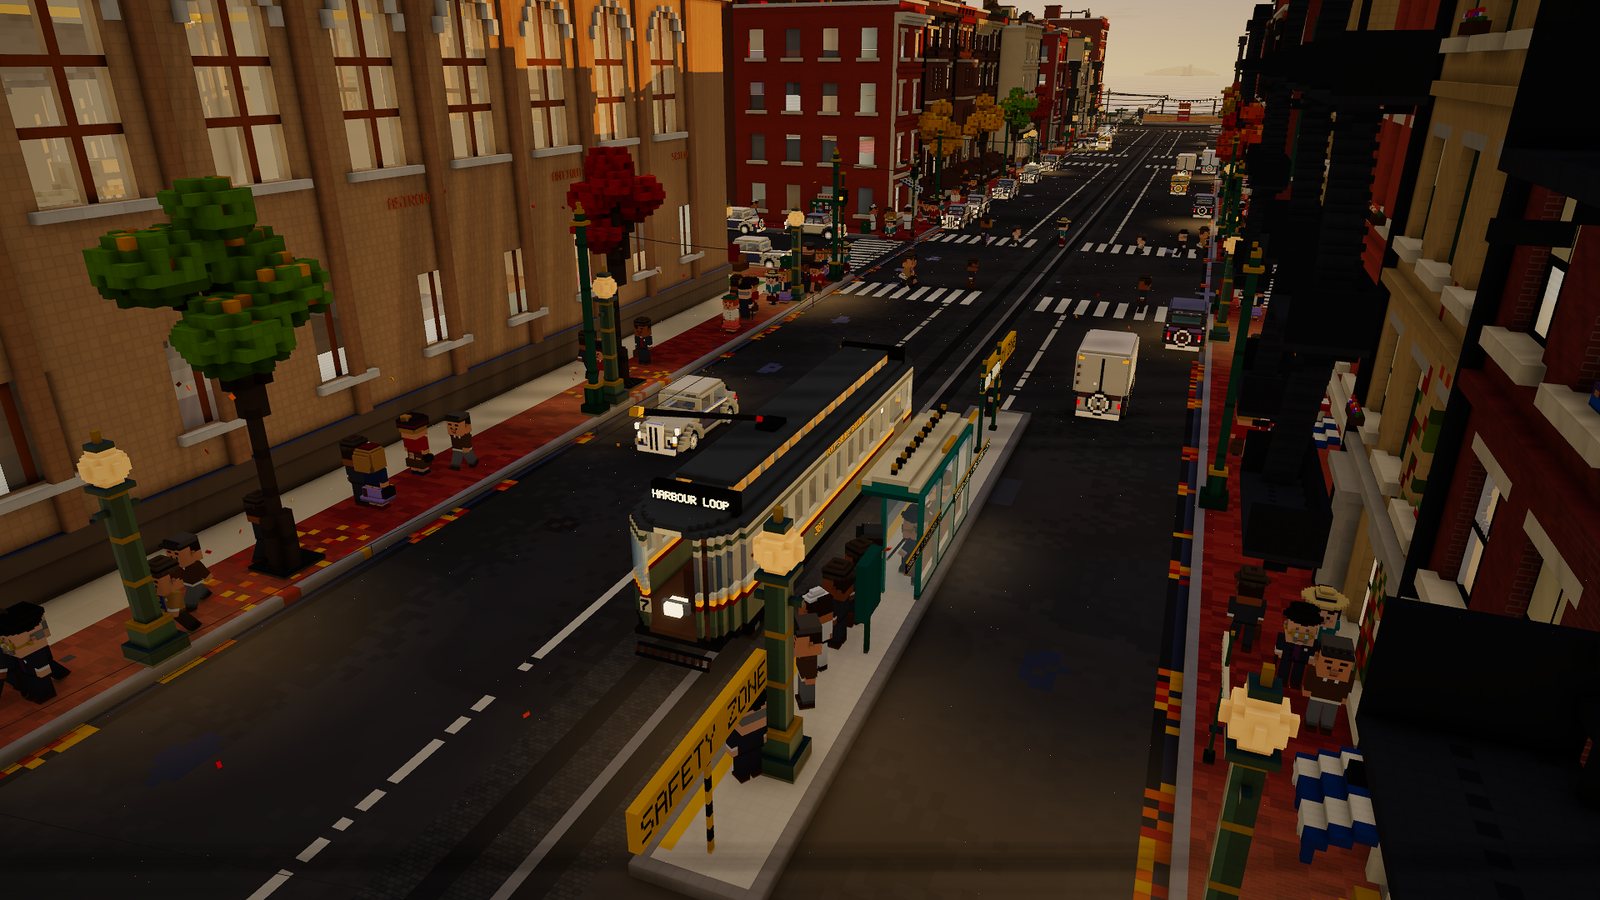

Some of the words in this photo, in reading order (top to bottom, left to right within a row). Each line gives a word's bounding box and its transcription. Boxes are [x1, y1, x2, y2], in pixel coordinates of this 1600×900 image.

[651, 488, 697, 506] HARBOUR
[702, 497, 730, 511] LOOP
[640, 599, 649, 610] 7
[641, 723, 716, 844] SAFETY
[726, 660, 766, 731] ZONE
